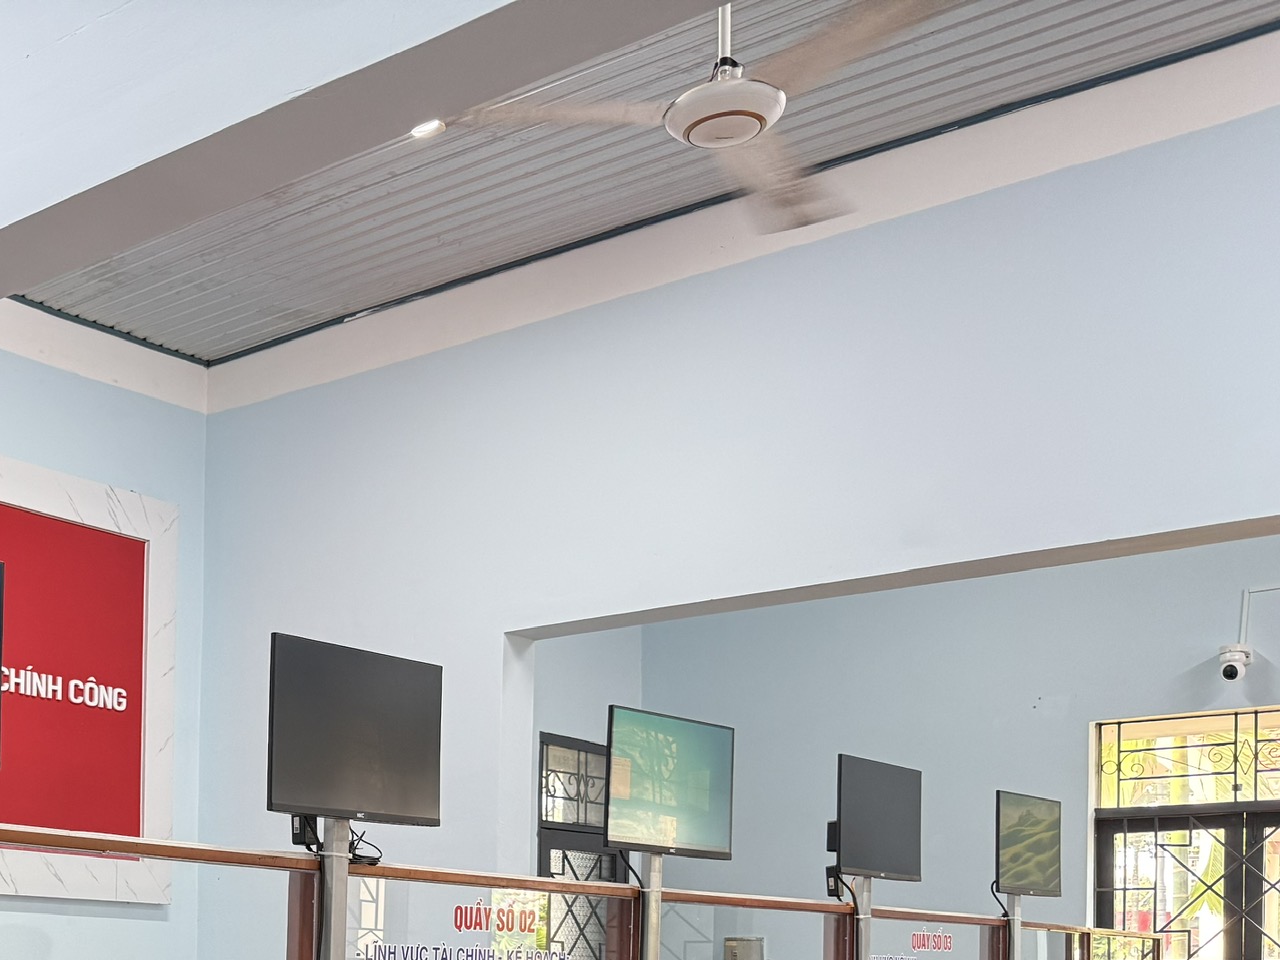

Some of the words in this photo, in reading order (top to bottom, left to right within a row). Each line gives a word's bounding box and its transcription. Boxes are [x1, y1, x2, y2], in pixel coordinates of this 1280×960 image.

[68, 676, 127, 711] CÔNG
[453, 898, 491, 932] QUẦY
[496, 900, 515, 932] SỐ
[518, 909, 536, 933] 02
[943, 934, 953, 952] 03
